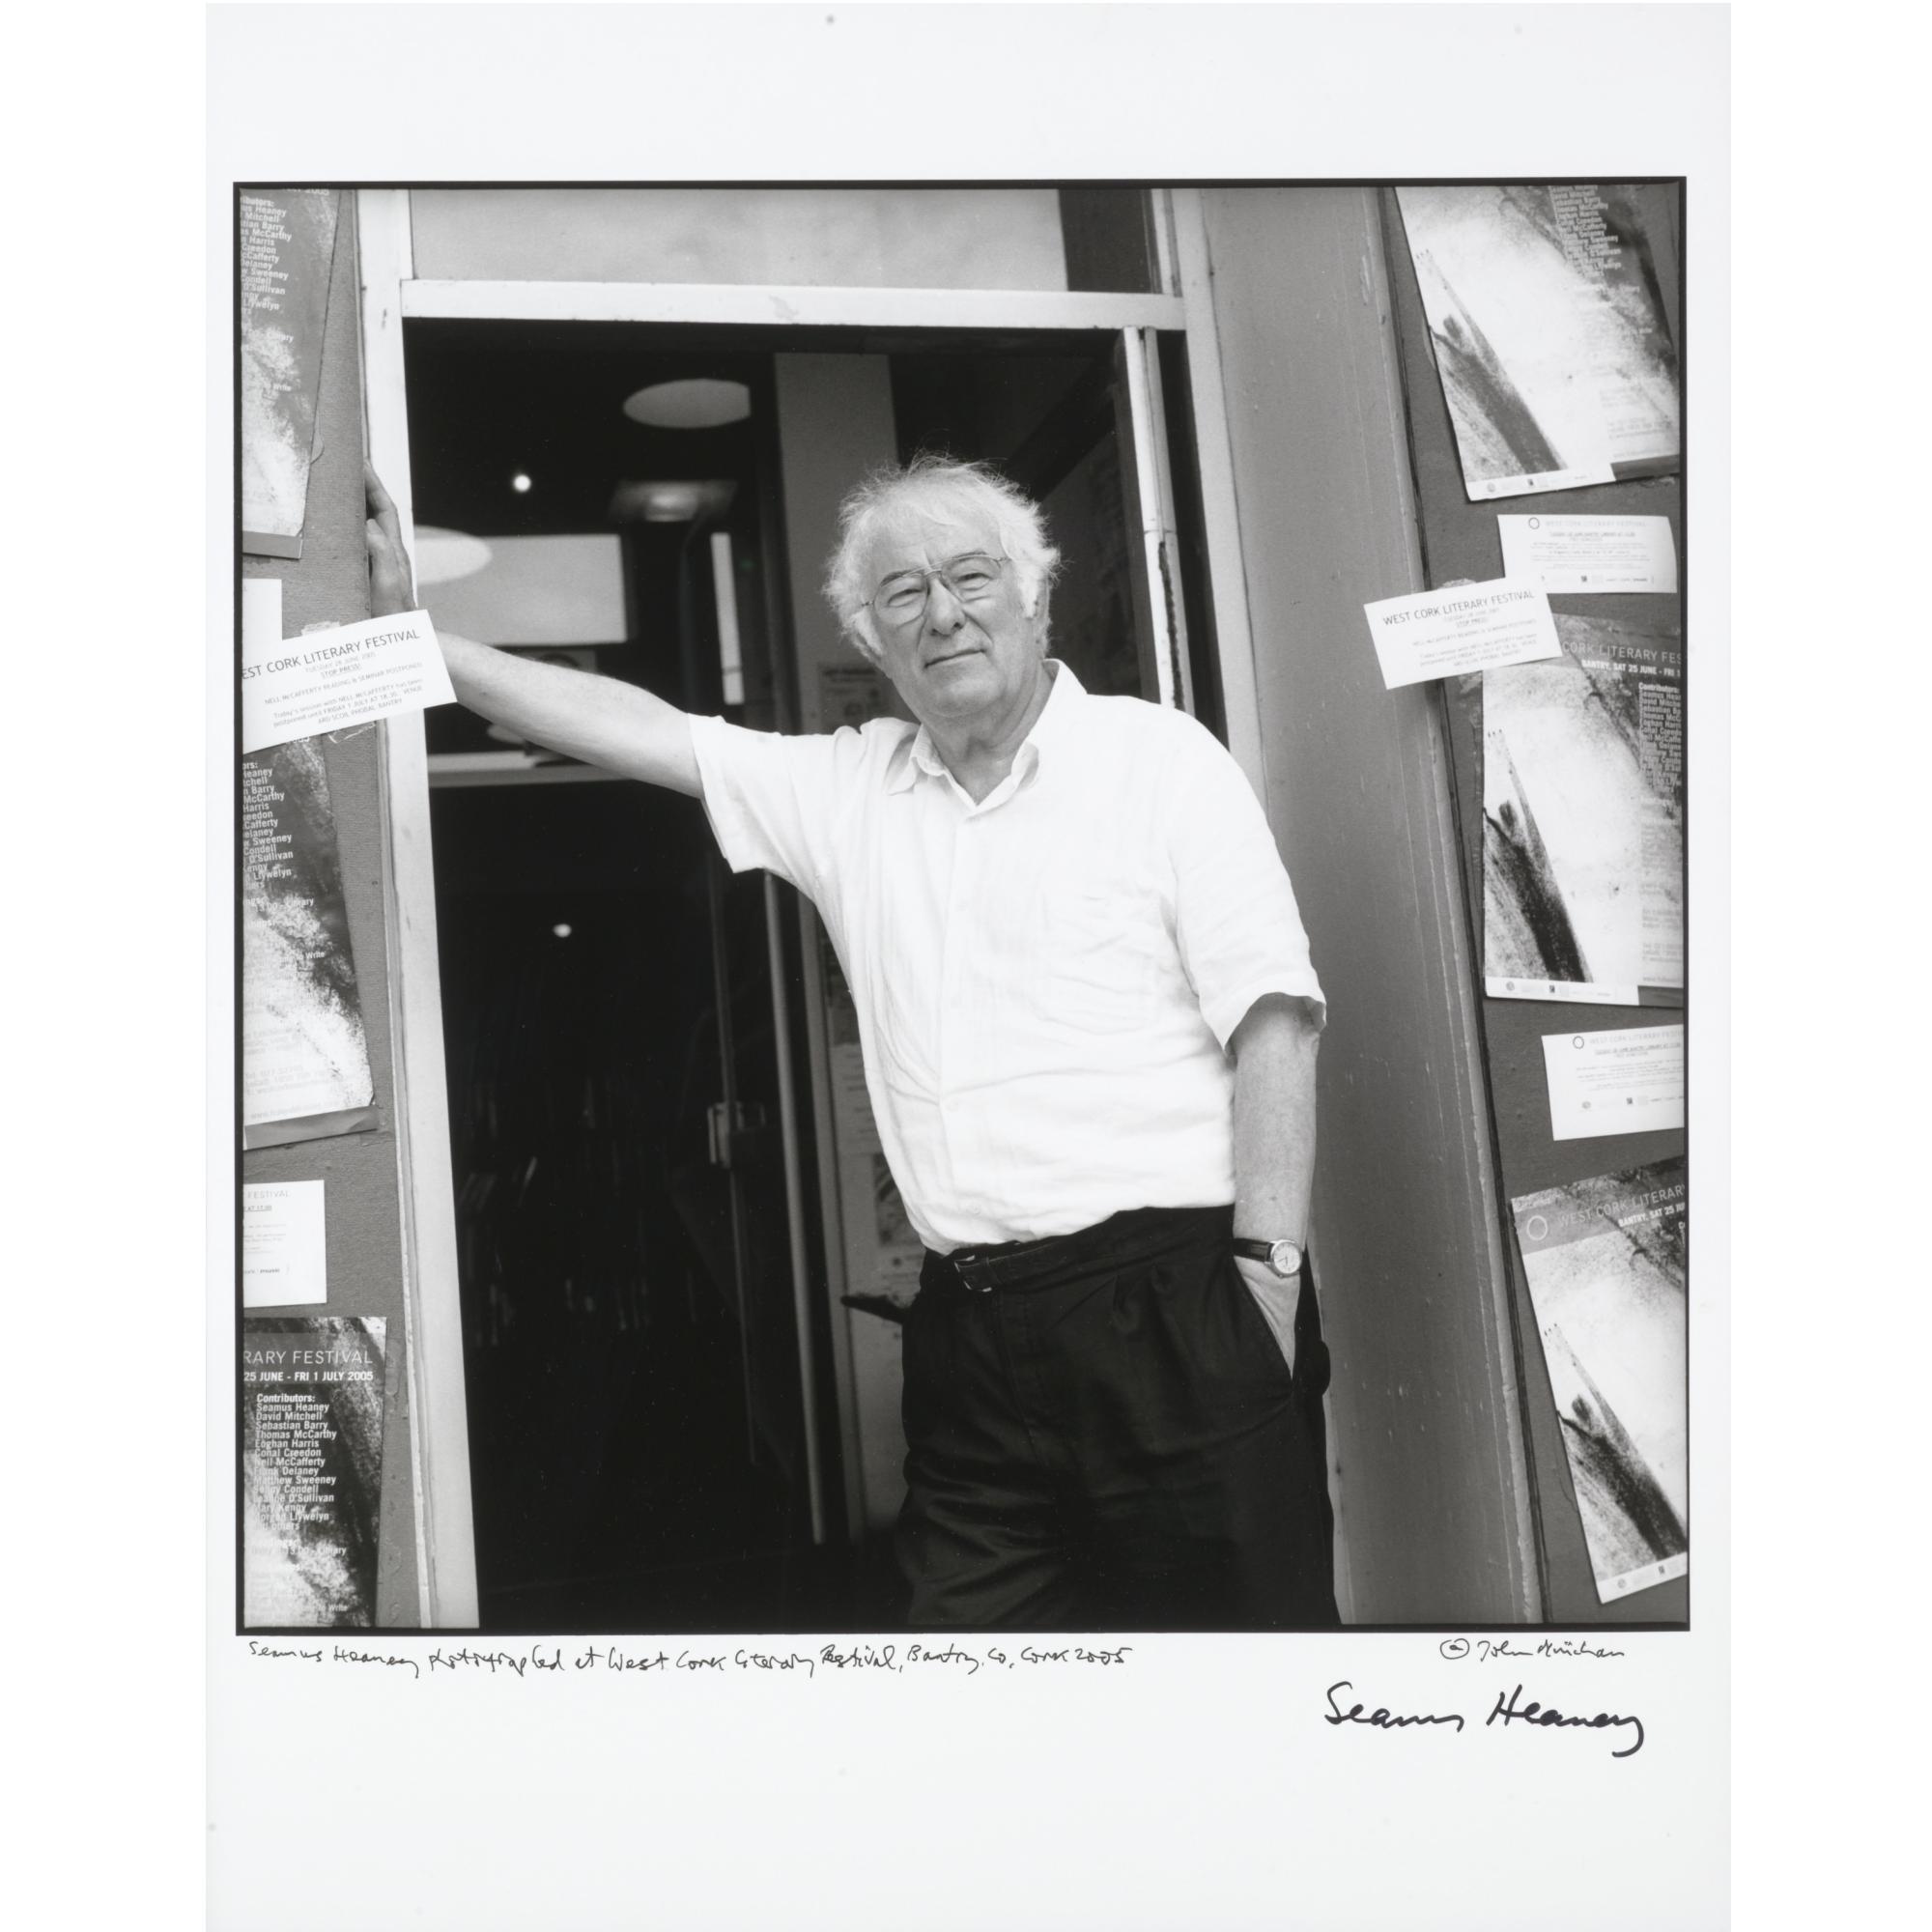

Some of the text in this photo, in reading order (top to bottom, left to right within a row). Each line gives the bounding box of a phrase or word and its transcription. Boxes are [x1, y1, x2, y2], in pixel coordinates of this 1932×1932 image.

[255, 206, 287, 217] Heaney
[244, 213, 279, 222] Mitchell
[262, 222, 284, 232] Barry
[249, 236, 274, 245] Harris
[252, 230, 292, 242] McCarthy
[242, 245, 276, 254] Creedon
[251, 269, 289, 280] Sweeney
[1382, 588, 1534, 625] WEST CORK LITERARY FESTIVAL
[242, 628, 419, 680] EST CORK LITERARY FESTIVAL
[1562, 641, 1593, 653] CORK
[1600, 644, 1657, 662] LITERARY
[320, 668, 338, 677] STOP
[1613, 663, 1626, 671] SAT
[1629, 664, 1637, 672] 25
[1640, 666, 1657, 674] JUNE
[1663, 668, 1675, 676] FRI
[272, 707, 298, 719] Today's
[323, 705, 345, 714] FRIDAY
[252, 785, 275, 794] Barry
[243, 792, 285, 804] McCarthy
[243, 802, 270, 812] Harris
[253, 835, 292, 846] Sweeney
[244, 844, 277, 855] Condell
[249, 852, 294, 863] O'Sullivan
[247, 1190, 290, 1199] FESTIVAL
[1559, 1209, 1591, 1227] WEST
[1596, 1201, 1626, 1217] CORK
[1650, 1208, 1662, 1219] SAT
[244, 1350, 374, 1364] RARY FESTIVAL
[244, 1371, 374, 1381] 25 JUNE FRI 1 JULY 2005
[257, 1393, 315, 1403] Contributors:
[257, 1403, 329, 1413] Seamus Heaney
[255, 1421, 328, 1431] Sebastian Barry
[294, 1431, 337, 1441] McCarthy
[255, 1439, 288, 1449] Eoghan
[275, 1457, 326, 1467] McCafferty
[282, 1466, 319, 1476] Delaney
[296, 1475, 336, 1485] Sweeney
[284, 1484, 318, 1492] Condell
[278, 1503, 306, 1512] Kenny
[290, 1511, 328, 1522] Llywelyn
[1477, 1640, 1534, 1662] John
[249, 1641, 323, 1662] Seamus
[333, 1645, 419, 1679] Heaney
[575, 1646, 605, 1668] at
[608, 1646, 670, 1671] West
[675, 1651, 727, 1670] Cork
[1020, 1647, 1070, 1664] Cork
[1074, 1647, 1135, 1665] 2005
[1486, 1683, 1644, 1758] Heaney
